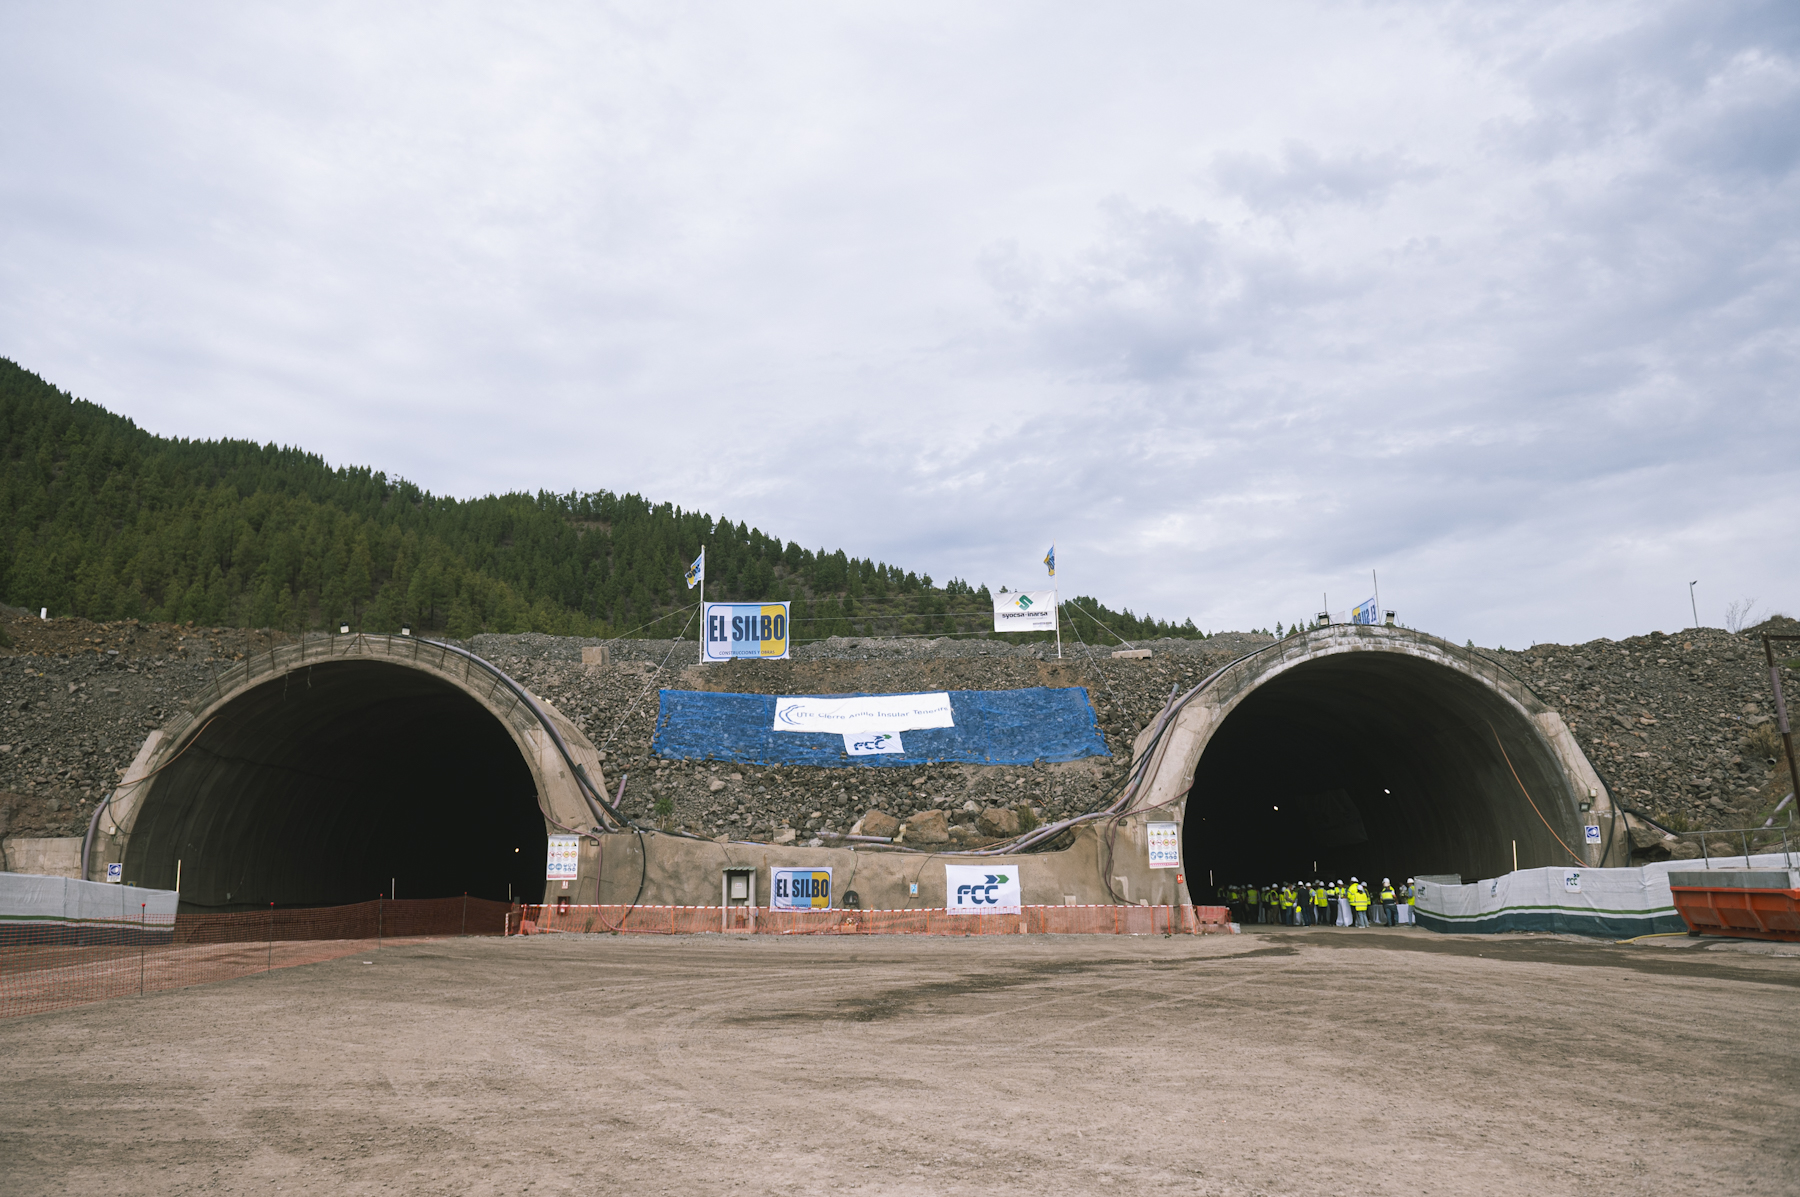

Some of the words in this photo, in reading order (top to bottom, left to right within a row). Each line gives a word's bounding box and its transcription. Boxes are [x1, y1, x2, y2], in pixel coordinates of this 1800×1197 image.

[709, 615, 728, 642] EL
[732, 614, 785, 642] SILBO
[849, 711, 874, 719] Anillo
[853, 739, 886, 751] FCC
[777, 878, 789, 898] EL
[792, 878, 829, 898] SILBO
[1566, 877, 1578, 886] FCC
[957, 884, 999, 905] FCC
